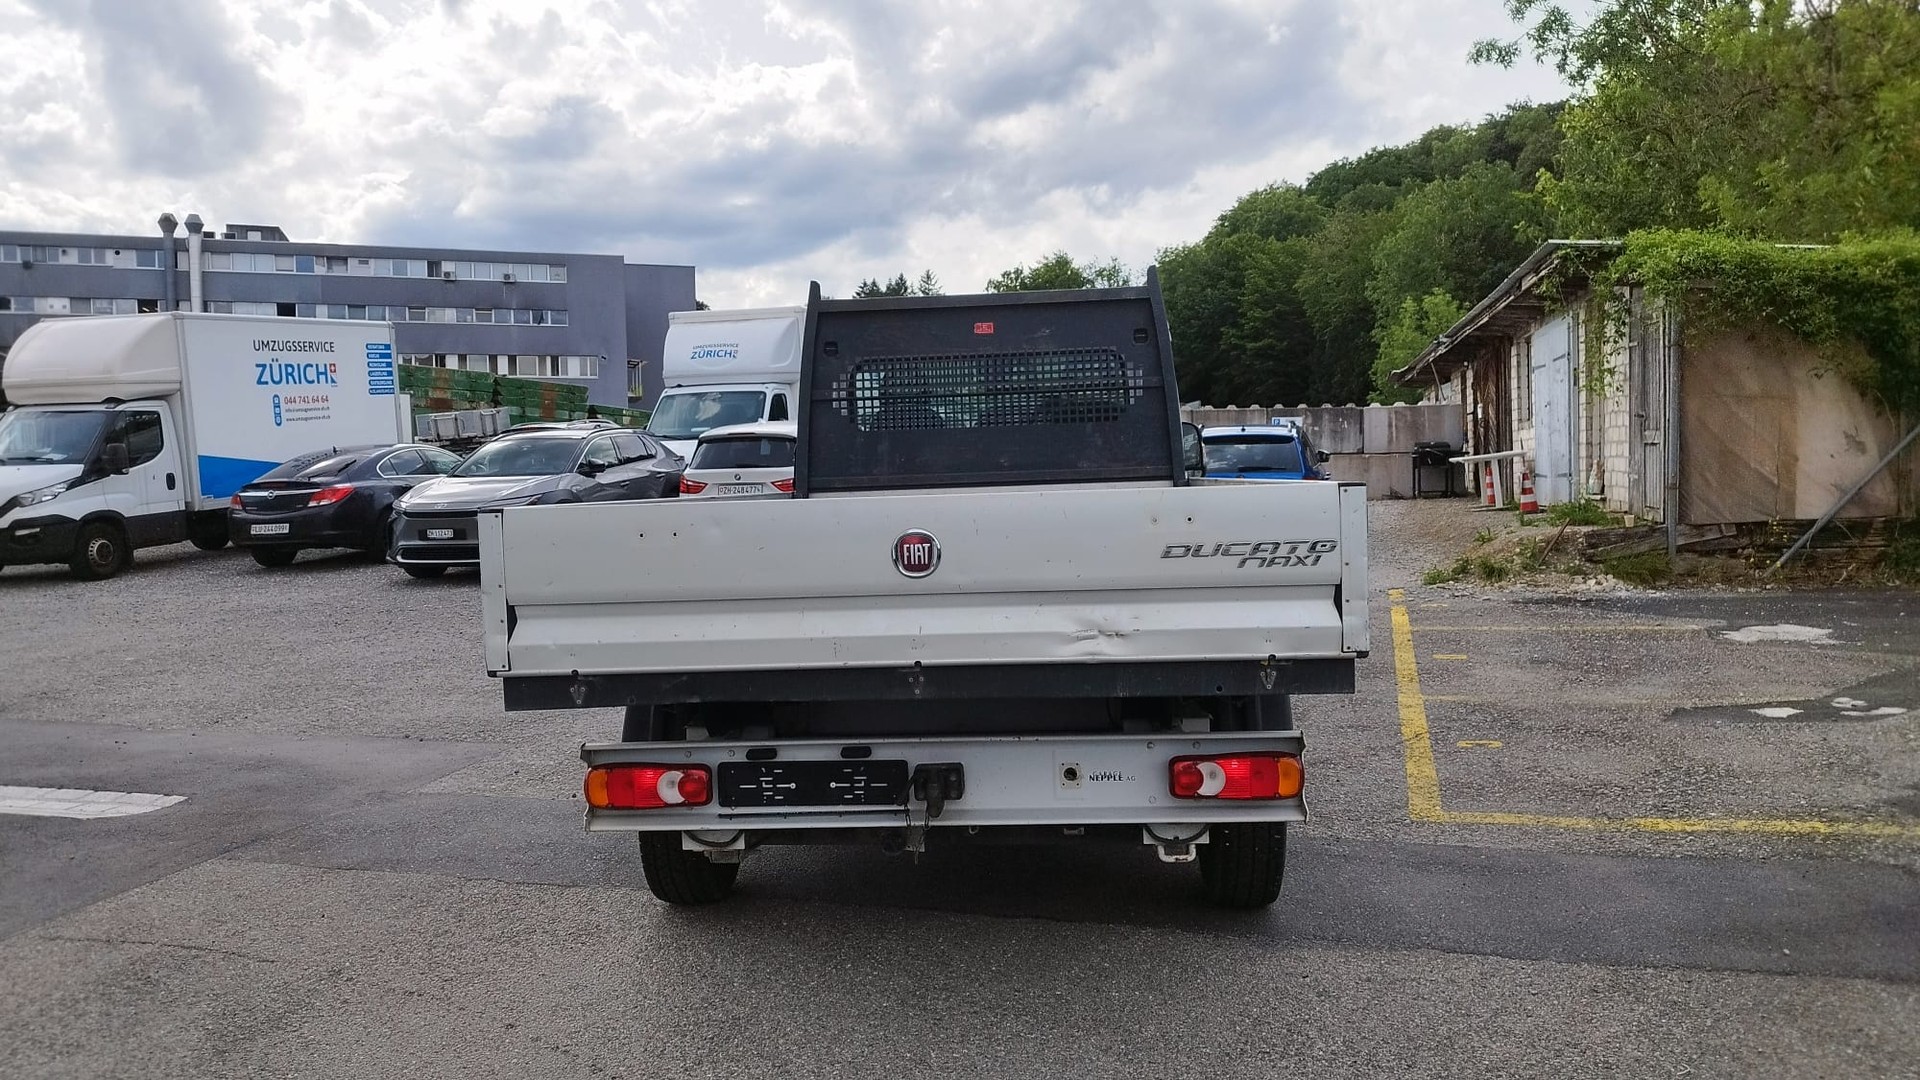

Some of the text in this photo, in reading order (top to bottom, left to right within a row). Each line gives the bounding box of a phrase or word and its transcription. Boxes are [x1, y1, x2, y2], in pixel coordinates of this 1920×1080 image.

[253, 339, 335, 352] UMZUGSSERVICE
[690, 349, 733, 360] ZÜRICH
[255, 358, 329, 385] ZÜRICH
[283, 395, 329, 404] 044 741 64 64
[903, 543, 931, 565] FIAT
[1160, 539, 1338, 559] DUCATO
[1236, 554, 1323, 568] MAXI
